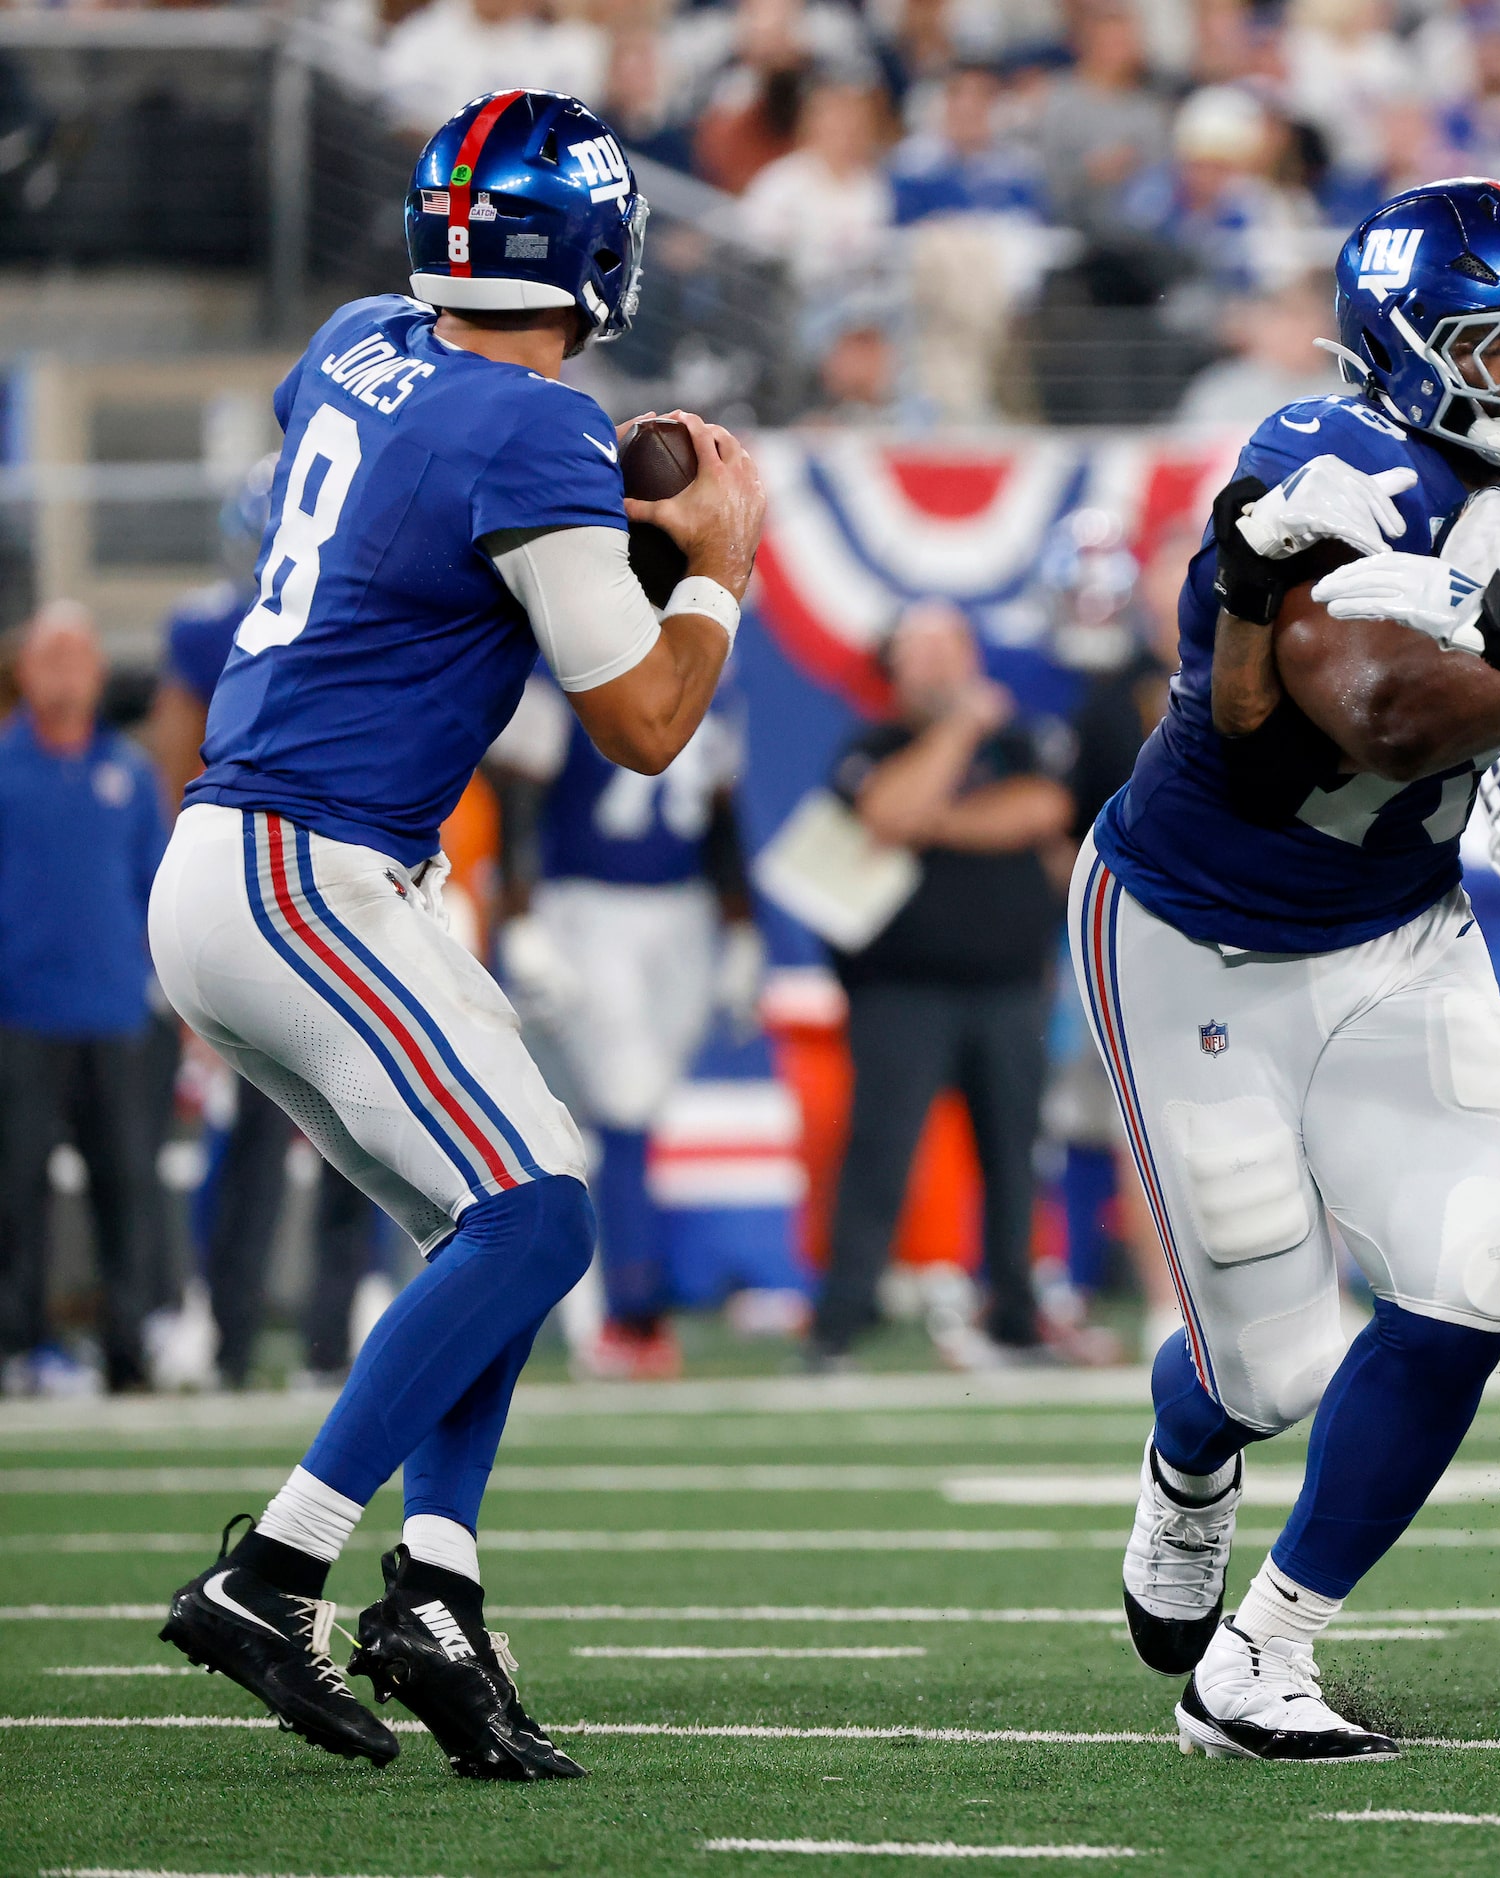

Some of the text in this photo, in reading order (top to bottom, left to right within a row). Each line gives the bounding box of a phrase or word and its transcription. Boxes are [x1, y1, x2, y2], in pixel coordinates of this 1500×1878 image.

[471, 208, 495, 218] CATCH
[448, 225, 469, 263] 8
[321, 332, 436, 416] JONES
[235, 402, 362, 657] 8
[1203, 1036, 1225, 1050] NFL
[410, 1600, 477, 1662] NIKE
